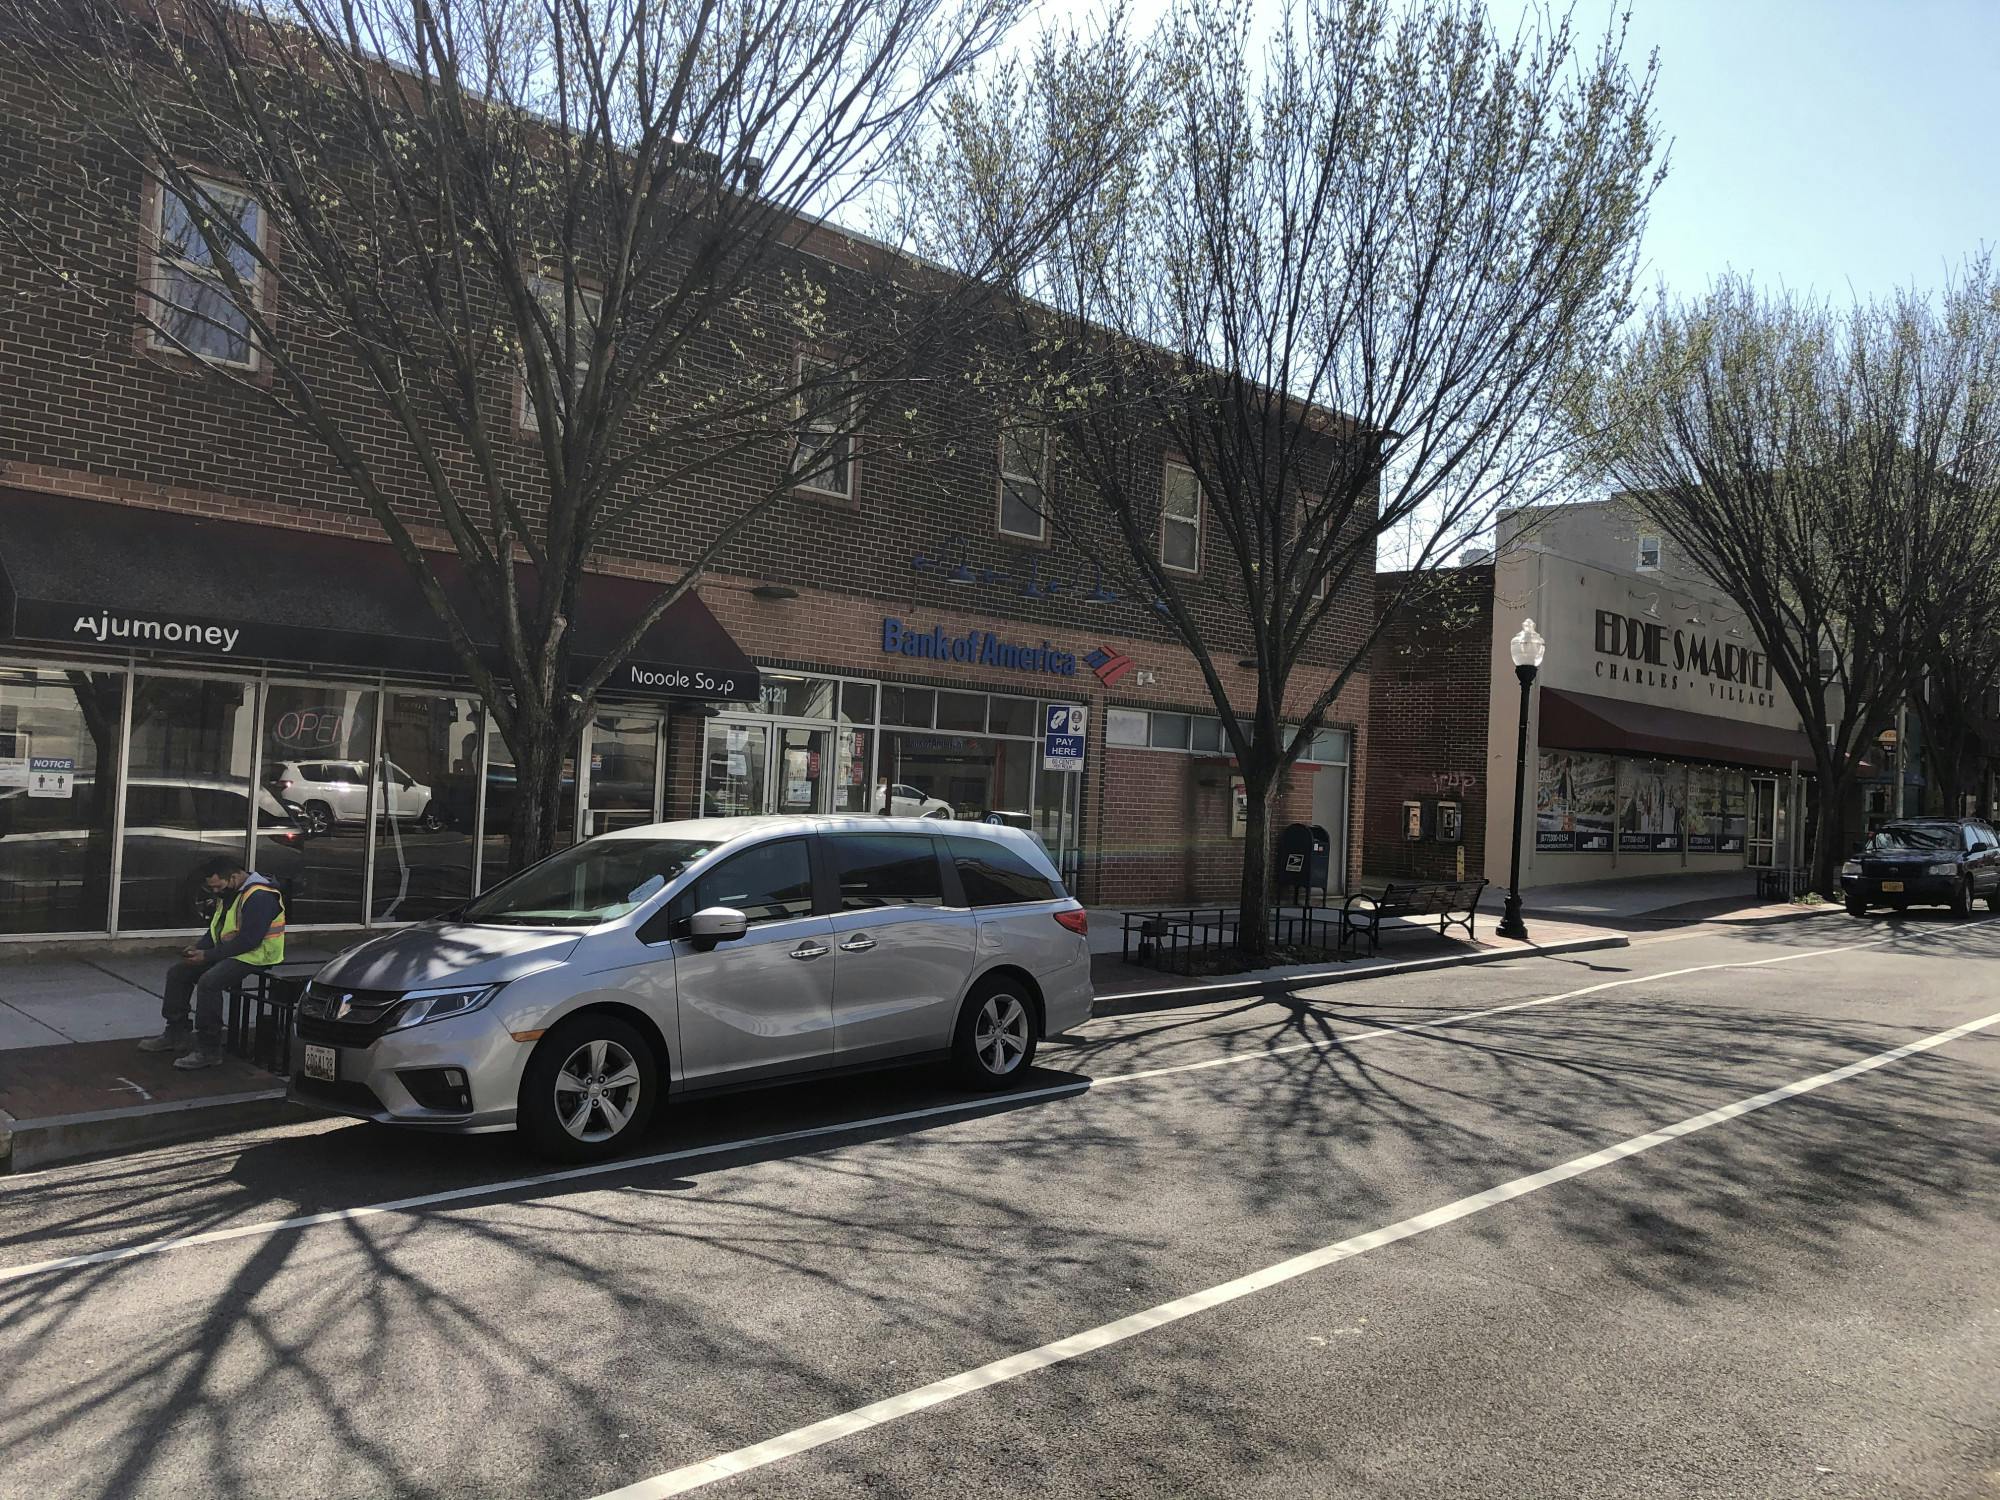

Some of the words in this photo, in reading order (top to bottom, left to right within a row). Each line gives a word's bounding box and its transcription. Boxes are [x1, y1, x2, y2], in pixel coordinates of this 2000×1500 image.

[883, 617, 949, 661] Bank
[951, 630, 980, 663] of
[979, 631, 1077, 676] America
[1687, 632, 1773, 691] MARKET
[760, 685, 788, 704] 3121
[1595, 661, 1678, 690] CHARLES
[1709, 682, 1775, 708] VILLAGE
[278, 712, 353, 743] OPEN
[1051, 747, 1077, 756] HERE
[1055, 737, 1074, 746] PAY
[33, 759, 72, 769] NOTICE
